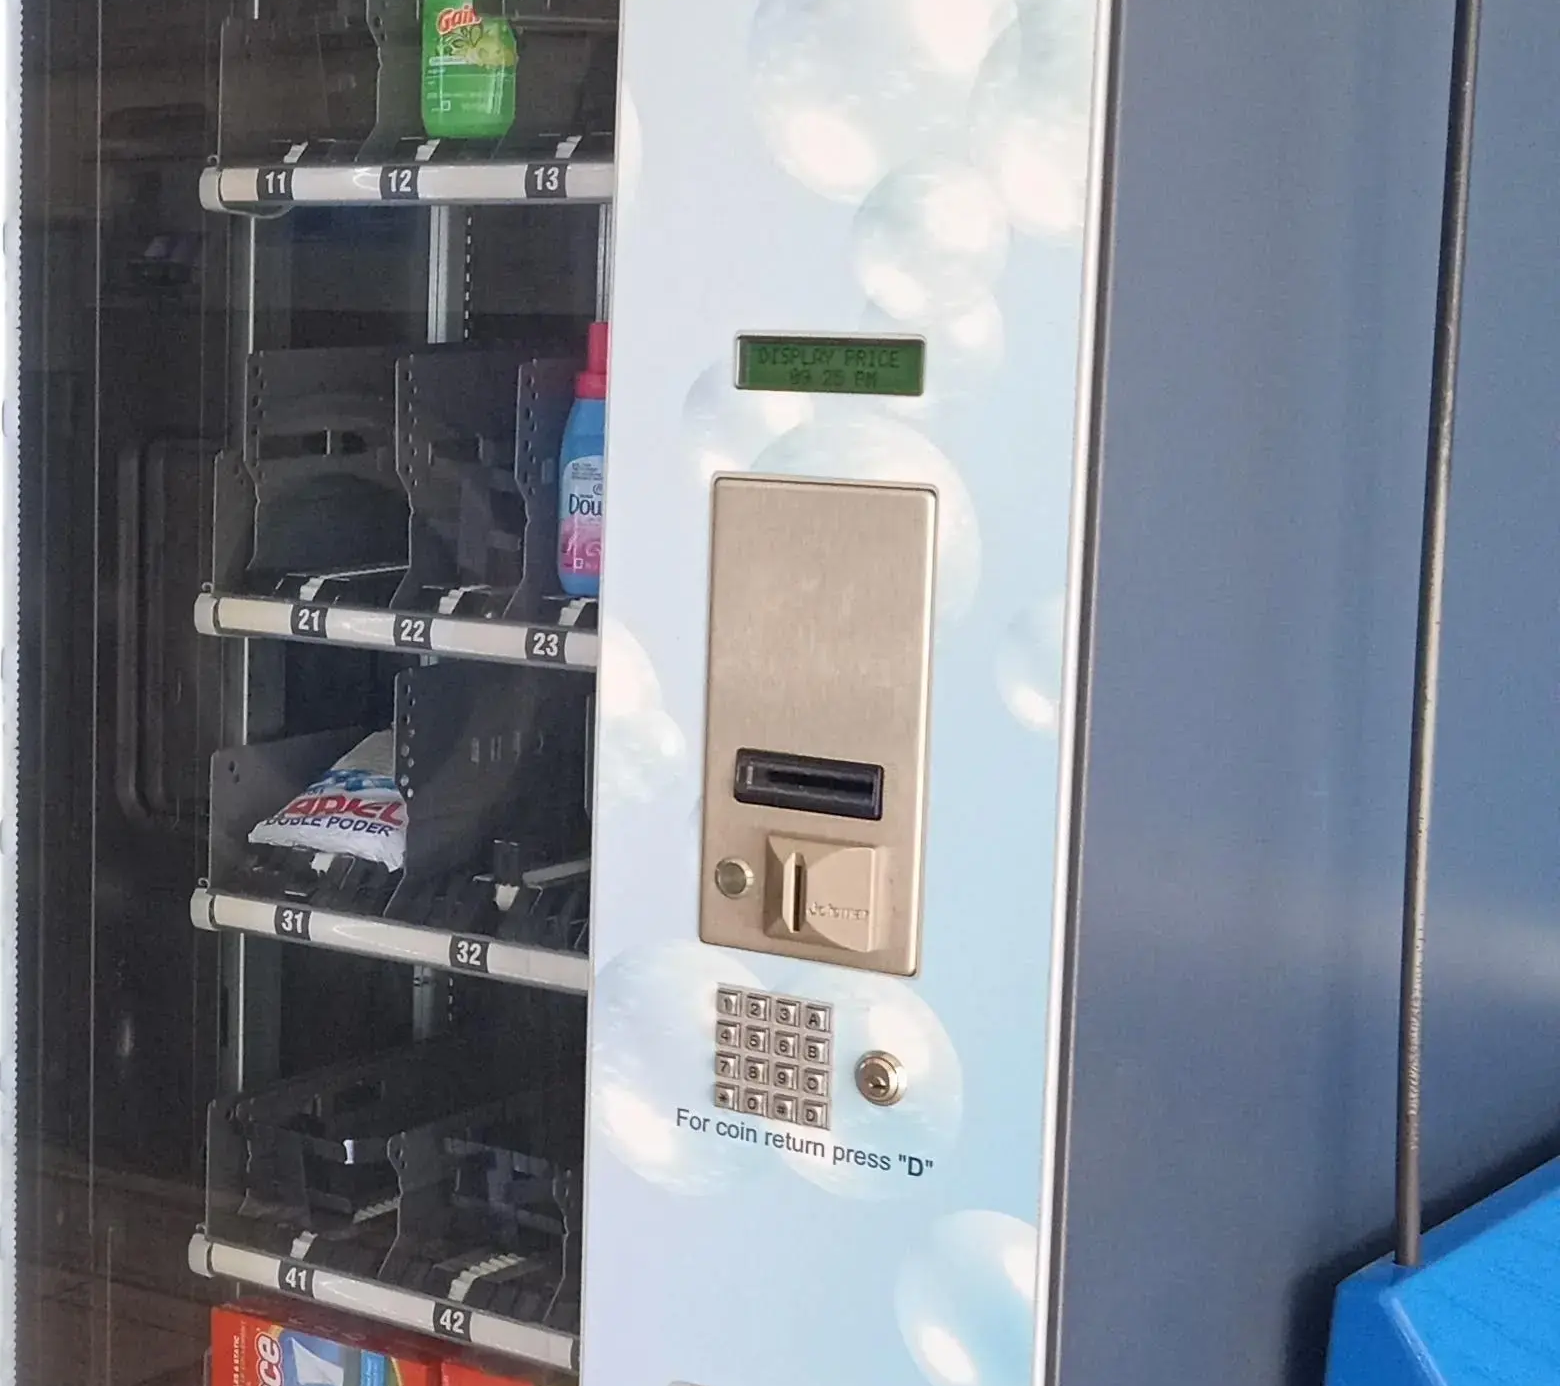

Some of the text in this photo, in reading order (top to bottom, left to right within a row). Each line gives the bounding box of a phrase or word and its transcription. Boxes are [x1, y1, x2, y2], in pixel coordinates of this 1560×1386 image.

[264, 166, 559, 195] 11 12 13
[758, 346, 900, 369] DISPLAY PRICE
[298, 609, 558, 657] 21 22 23
[326, 816, 394, 837] PODER
[281, 909, 482, 966] 31 32
[750, 1003, 760, 1016] 2
[779, 1007, 789, 1021] 3
[720, 1060, 729, 1072] 7
[676, 1107, 934, 1178] For coin return press "D"
[285, 1267, 464, 1334] 41 42
